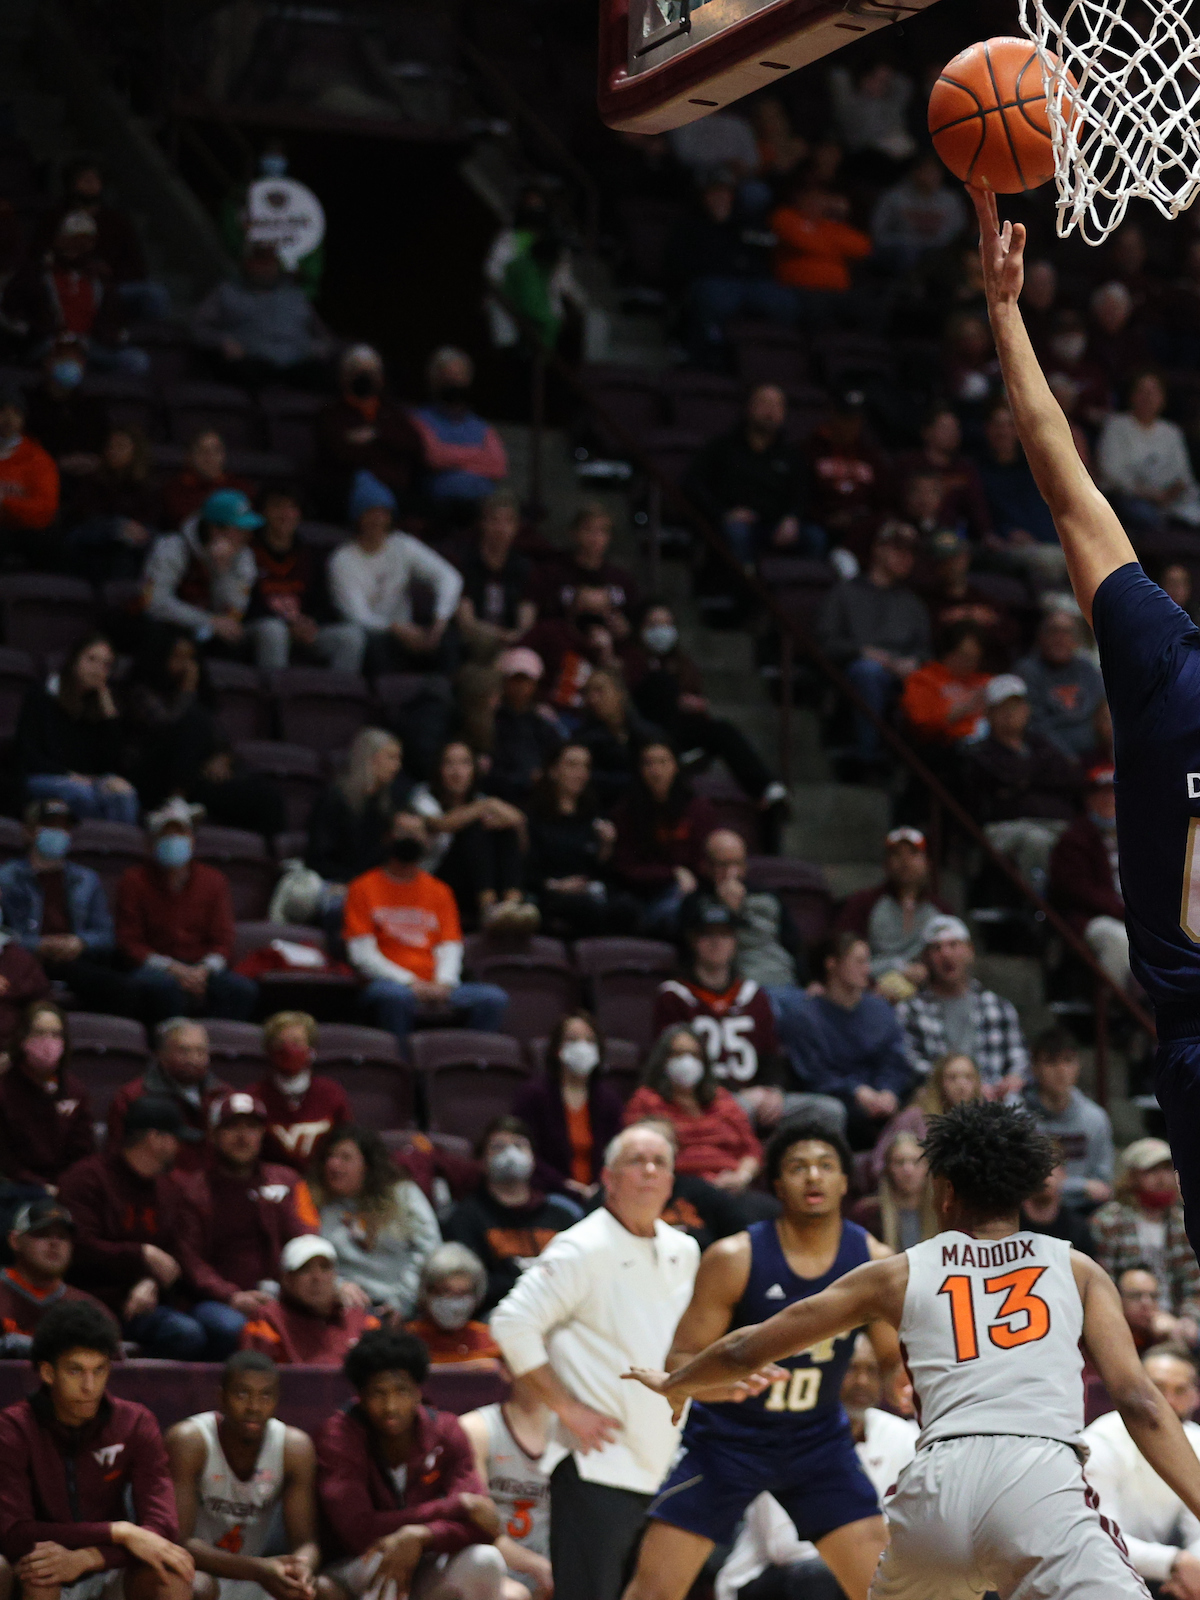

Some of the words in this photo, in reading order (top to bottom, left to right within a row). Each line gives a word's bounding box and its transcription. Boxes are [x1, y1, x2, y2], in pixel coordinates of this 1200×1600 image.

[692, 1015, 758, 1082] 25
[272, 1119, 331, 1157] VT
[942, 1239, 1036, 1268] MADDOX
[936, 1266, 1051, 1363] 13
[764, 1367, 822, 1412] 10
[91, 1443, 125, 1468] VT
[507, 1500, 536, 1539] 3
